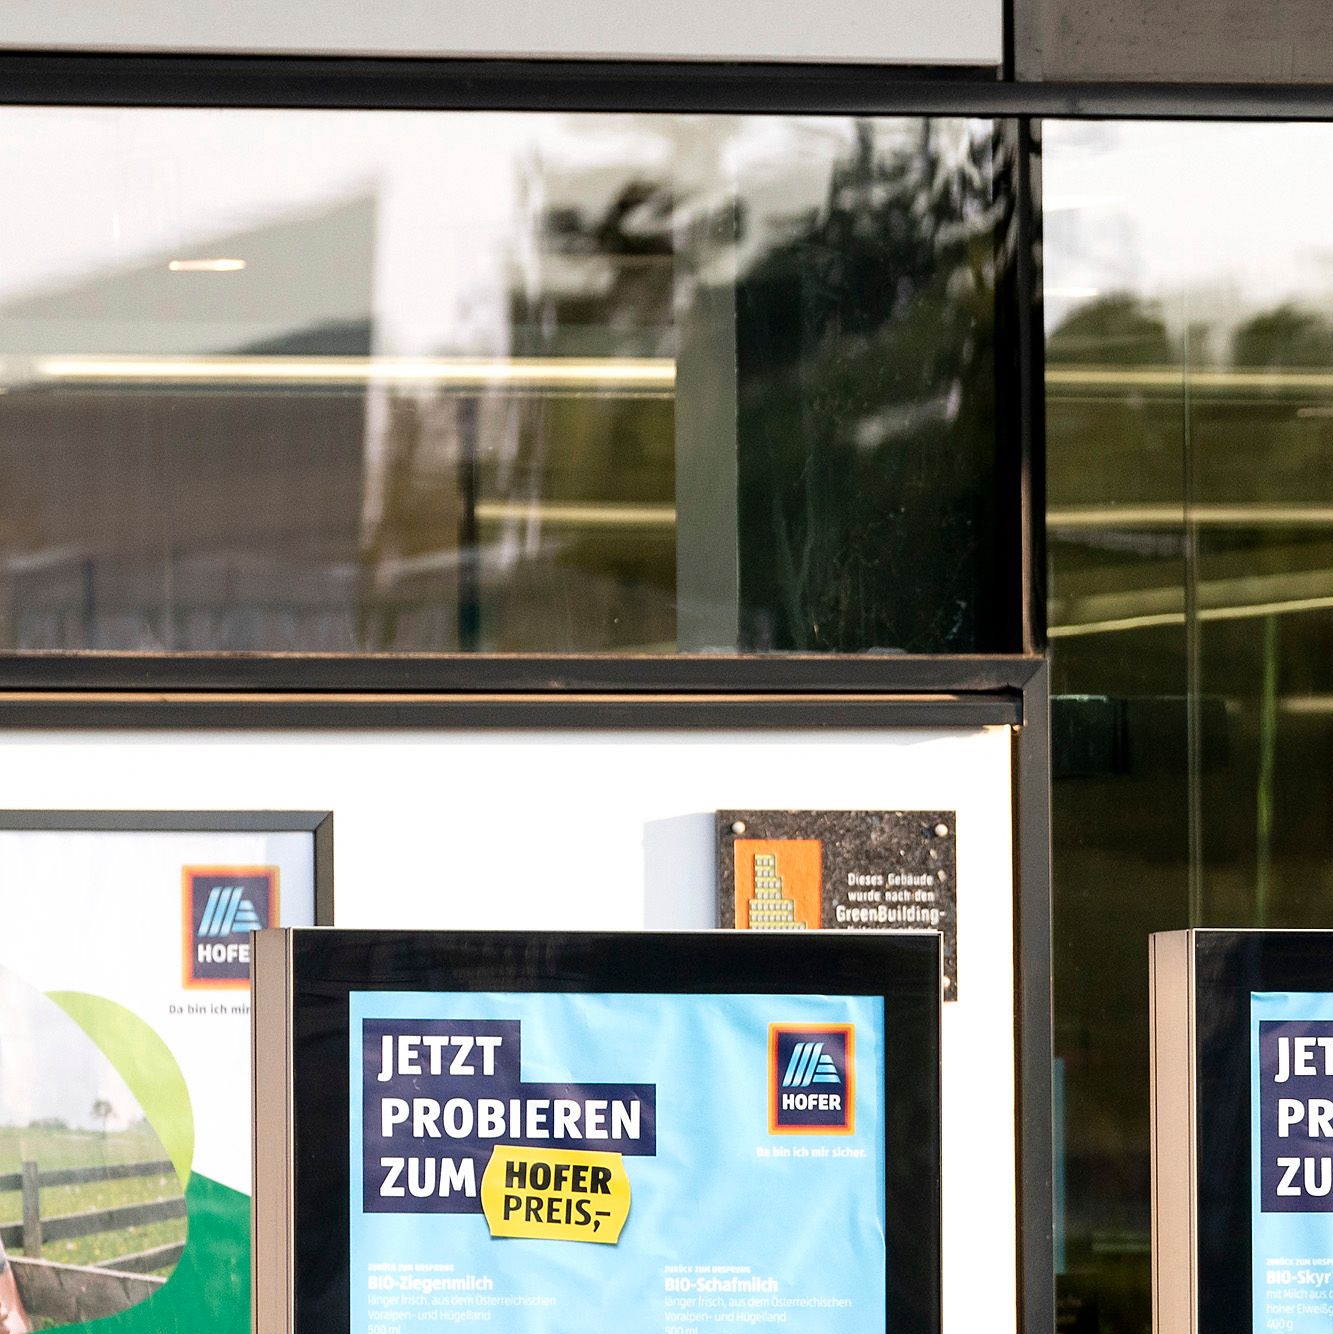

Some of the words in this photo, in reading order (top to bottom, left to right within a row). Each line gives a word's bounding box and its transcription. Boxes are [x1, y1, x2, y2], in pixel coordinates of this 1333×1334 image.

[847, 872, 883, 887] Dieses
[887, 870, 933, 886] Gebäude
[848, 888, 881, 903] wurde
[884, 888, 910, 902] nach
[914, 888, 935, 902] den
[836, 905, 946, 925] GreenBuilding-
[198, 943, 249, 963] HOFE
[378, 1035, 502, 1082] JETZT
[782, 1094, 841, 1112] HOFER
[380, 1098, 641, 1140] PROBIEREN
[380, 1157, 477, 1197] ZUM
[505, 1161, 612, 1194] HOFER
[502, 1197, 611, 1232] PREIS,-
[368, 1275, 493, 1293] BIO-Ziegenmilch
[664, 1277, 778, 1292] BIO-Schafmilch
